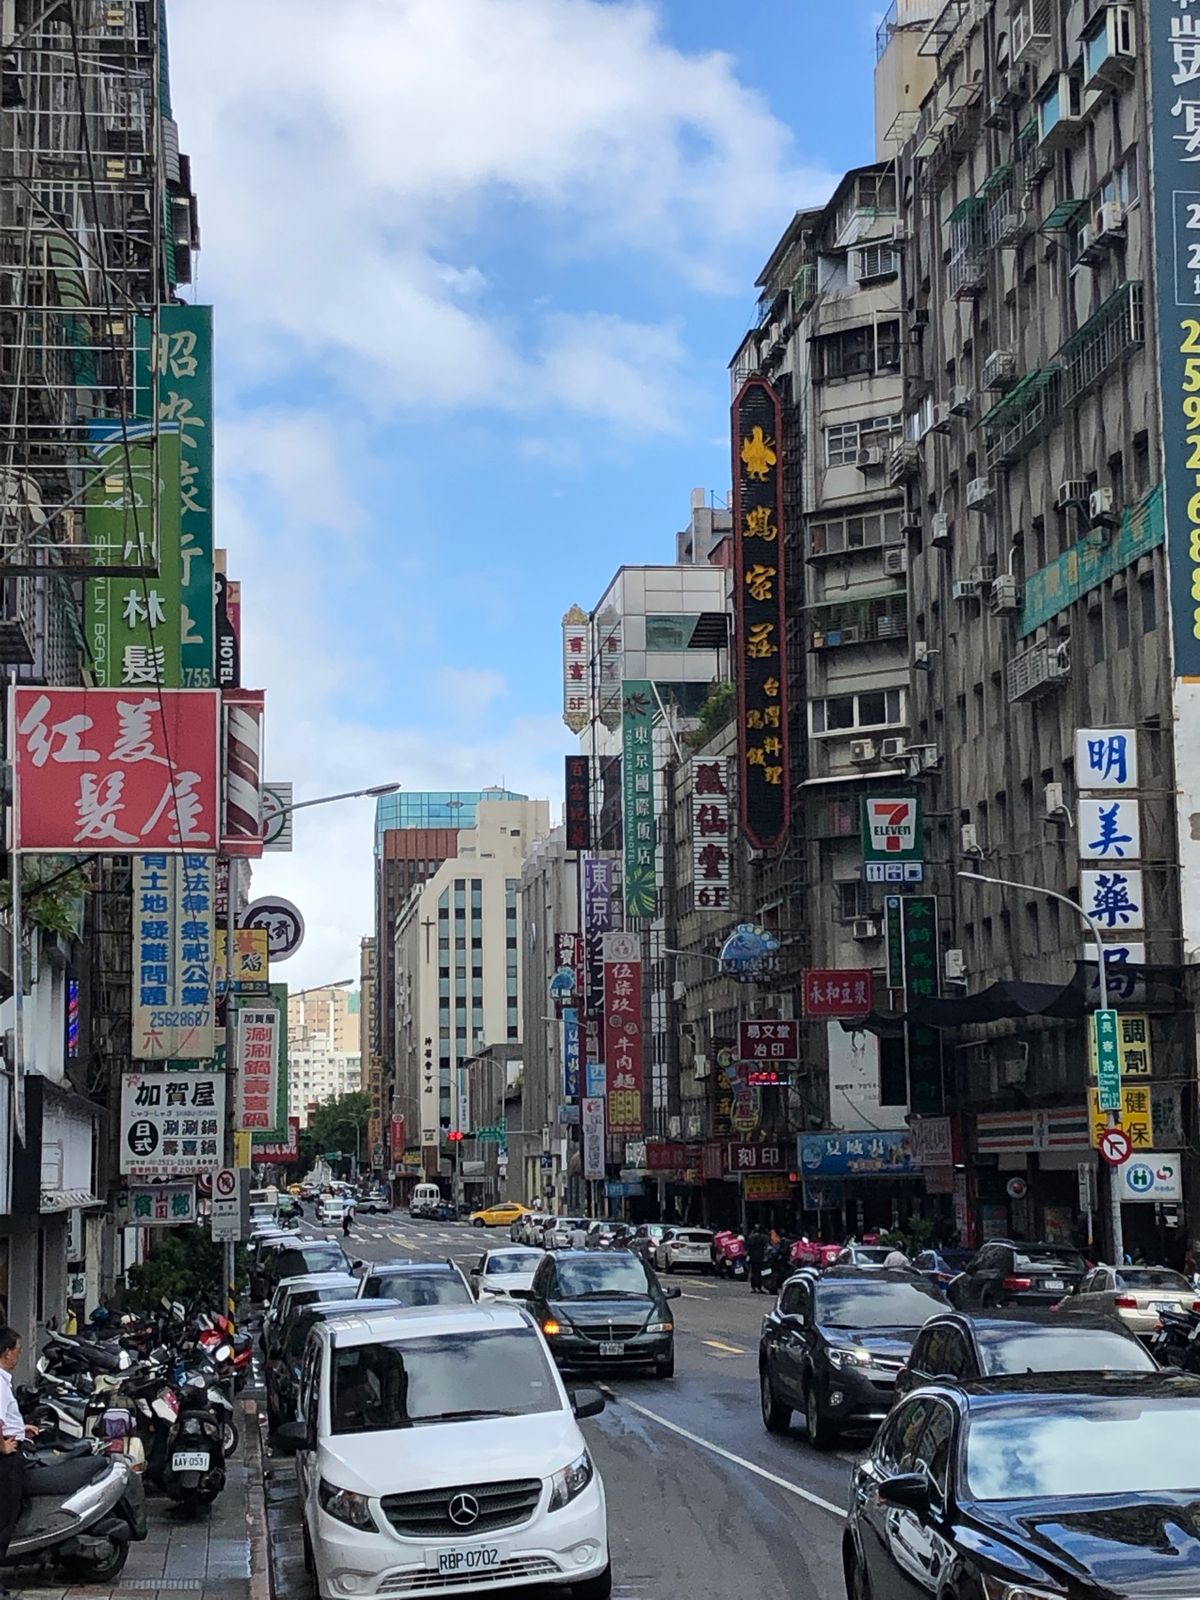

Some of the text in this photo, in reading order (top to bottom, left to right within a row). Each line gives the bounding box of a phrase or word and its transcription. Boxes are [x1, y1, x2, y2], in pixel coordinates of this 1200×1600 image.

[219, 635, 234, 685] HOTEL
[625, 729, 636, 865] TOKYO INTERNATIONAL HOTEL
[634, 725, 651, 866] 東京國際飯店
[1086, 734, 1139, 1000] 明美藥局
[698, 886, 728, 907] 6F
[139, 920, 169, 1006] 疑難問題
[181, 920, 210, 1006] 祭祀公業
[611, 963, 635, 1013] 伍柒玖
[809, 979, 867, 1006] 永和豆漿
[150, 1011, 210, 1028] 25628687
[243, 1013, 275, 1025] 加賀屋
[243, 1027, 272, 1075] 涮涮鍋
[613, 1036, 637, 1090] 牛肉麵
[1100, 1020, 1116, 1072] 長春路
[1121, 1018, 1148, 1074] 調劑
[134, 1081, 215, 1107] 加賀屋
[1124, 1091, 1149, 1145] 健保
[135, 1122, 153, 1153] 日式
[162, 1119, 218, 1136] 涮涮鍋
[162, 1139, 218, 1156] 壽喜鍋
[737, 1147, 780, 1166] 刻印
[439, 1549, 499, 1571] RBP-0702
